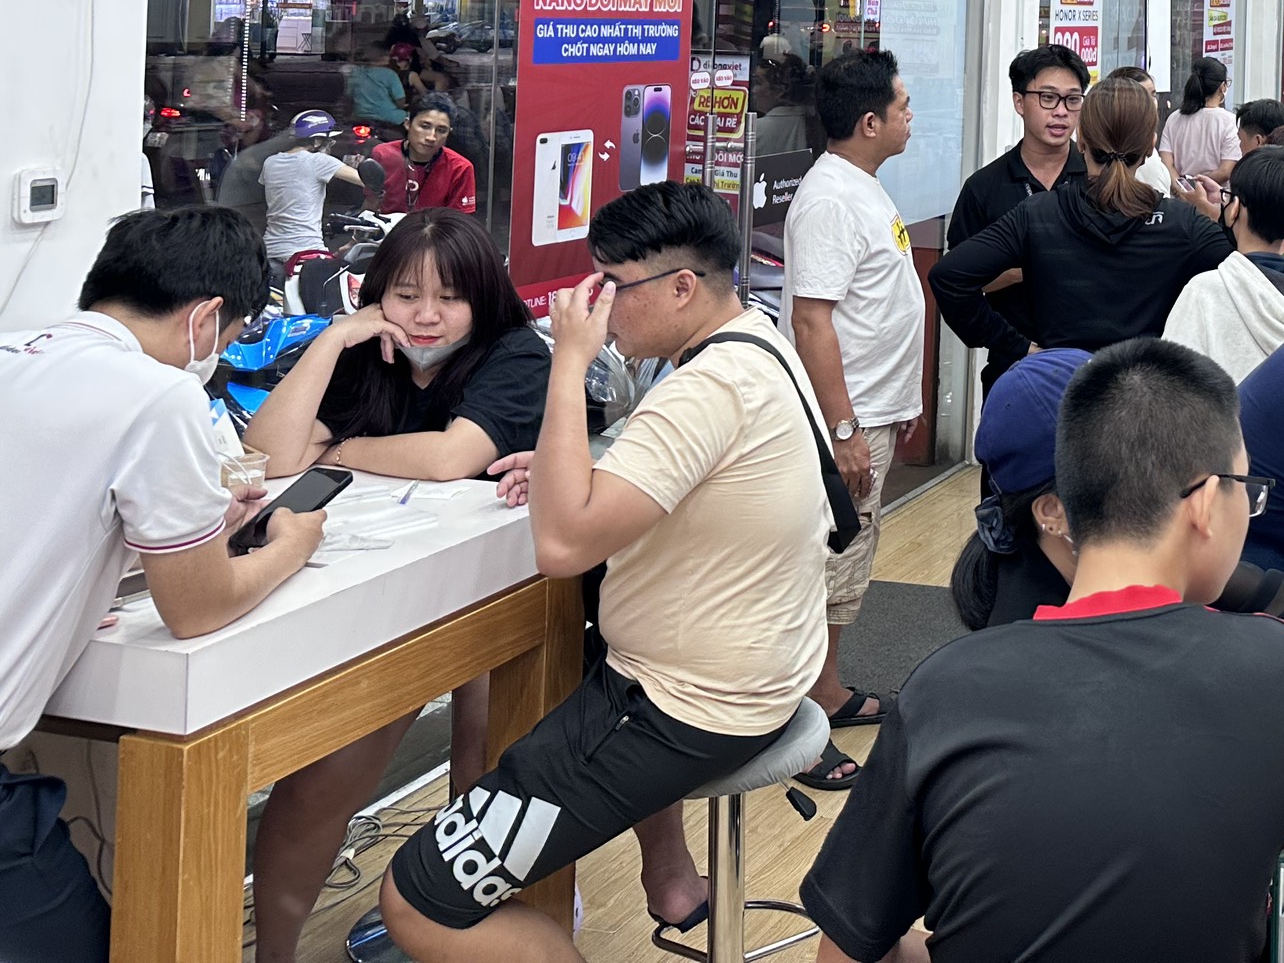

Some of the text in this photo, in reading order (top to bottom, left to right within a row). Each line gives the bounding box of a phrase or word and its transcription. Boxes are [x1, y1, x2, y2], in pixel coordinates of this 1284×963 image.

[537, 22, 679, 40] GIÁ THU CAO NHẤT THỊ TRƯỜNG
[562, 40, 657, 56] CHỐT NGAY HÔM NAY
